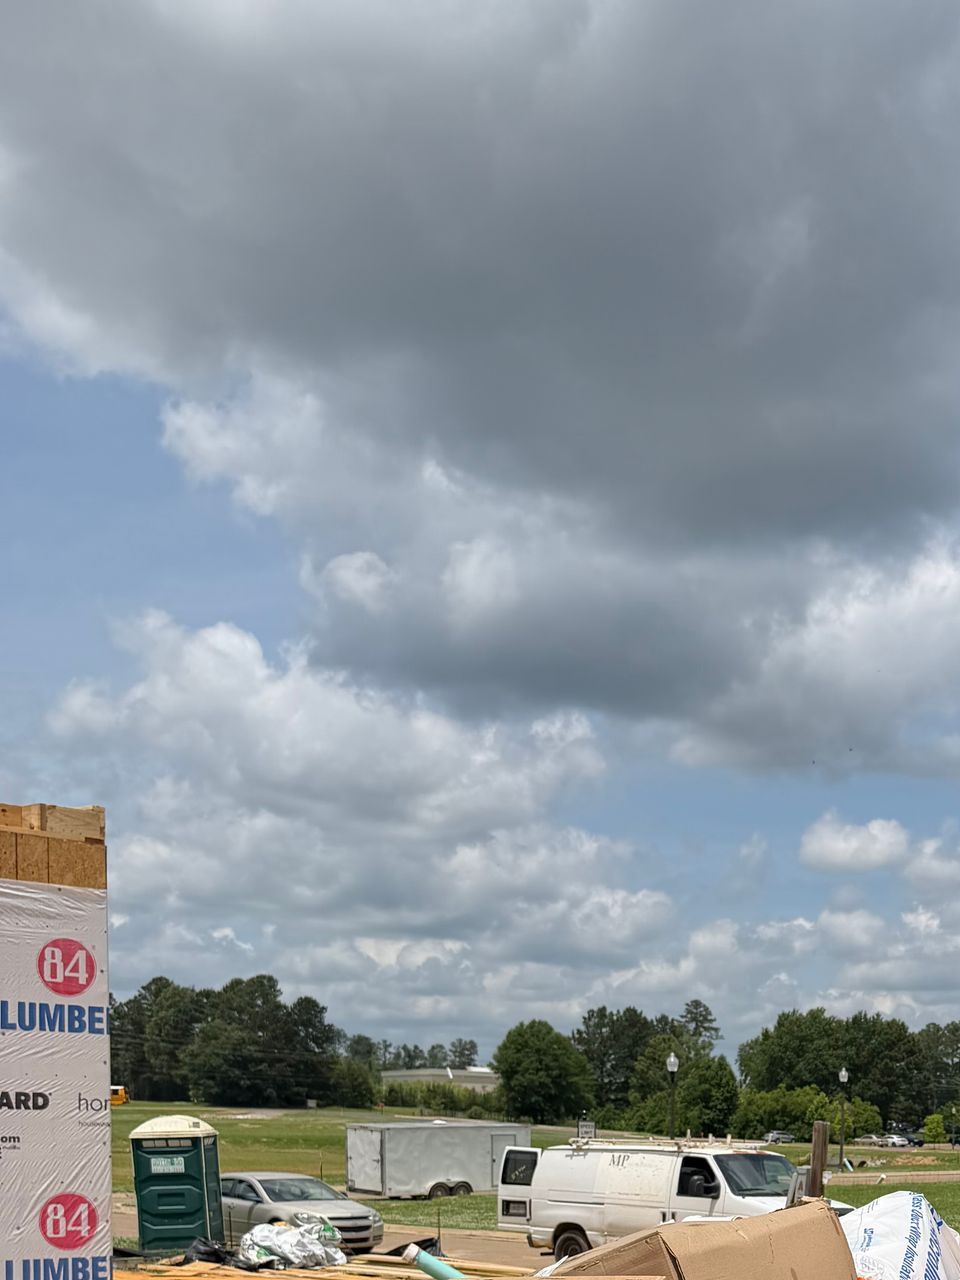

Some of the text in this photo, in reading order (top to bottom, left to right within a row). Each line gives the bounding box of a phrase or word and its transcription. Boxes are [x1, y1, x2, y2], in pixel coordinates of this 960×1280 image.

[43, 946, 88, 985] 84
[0, 1000, 110, 1035] LUMBE
[609, 1154, 629, 1168] MP
[46, 1203, 90, 1238] 84
